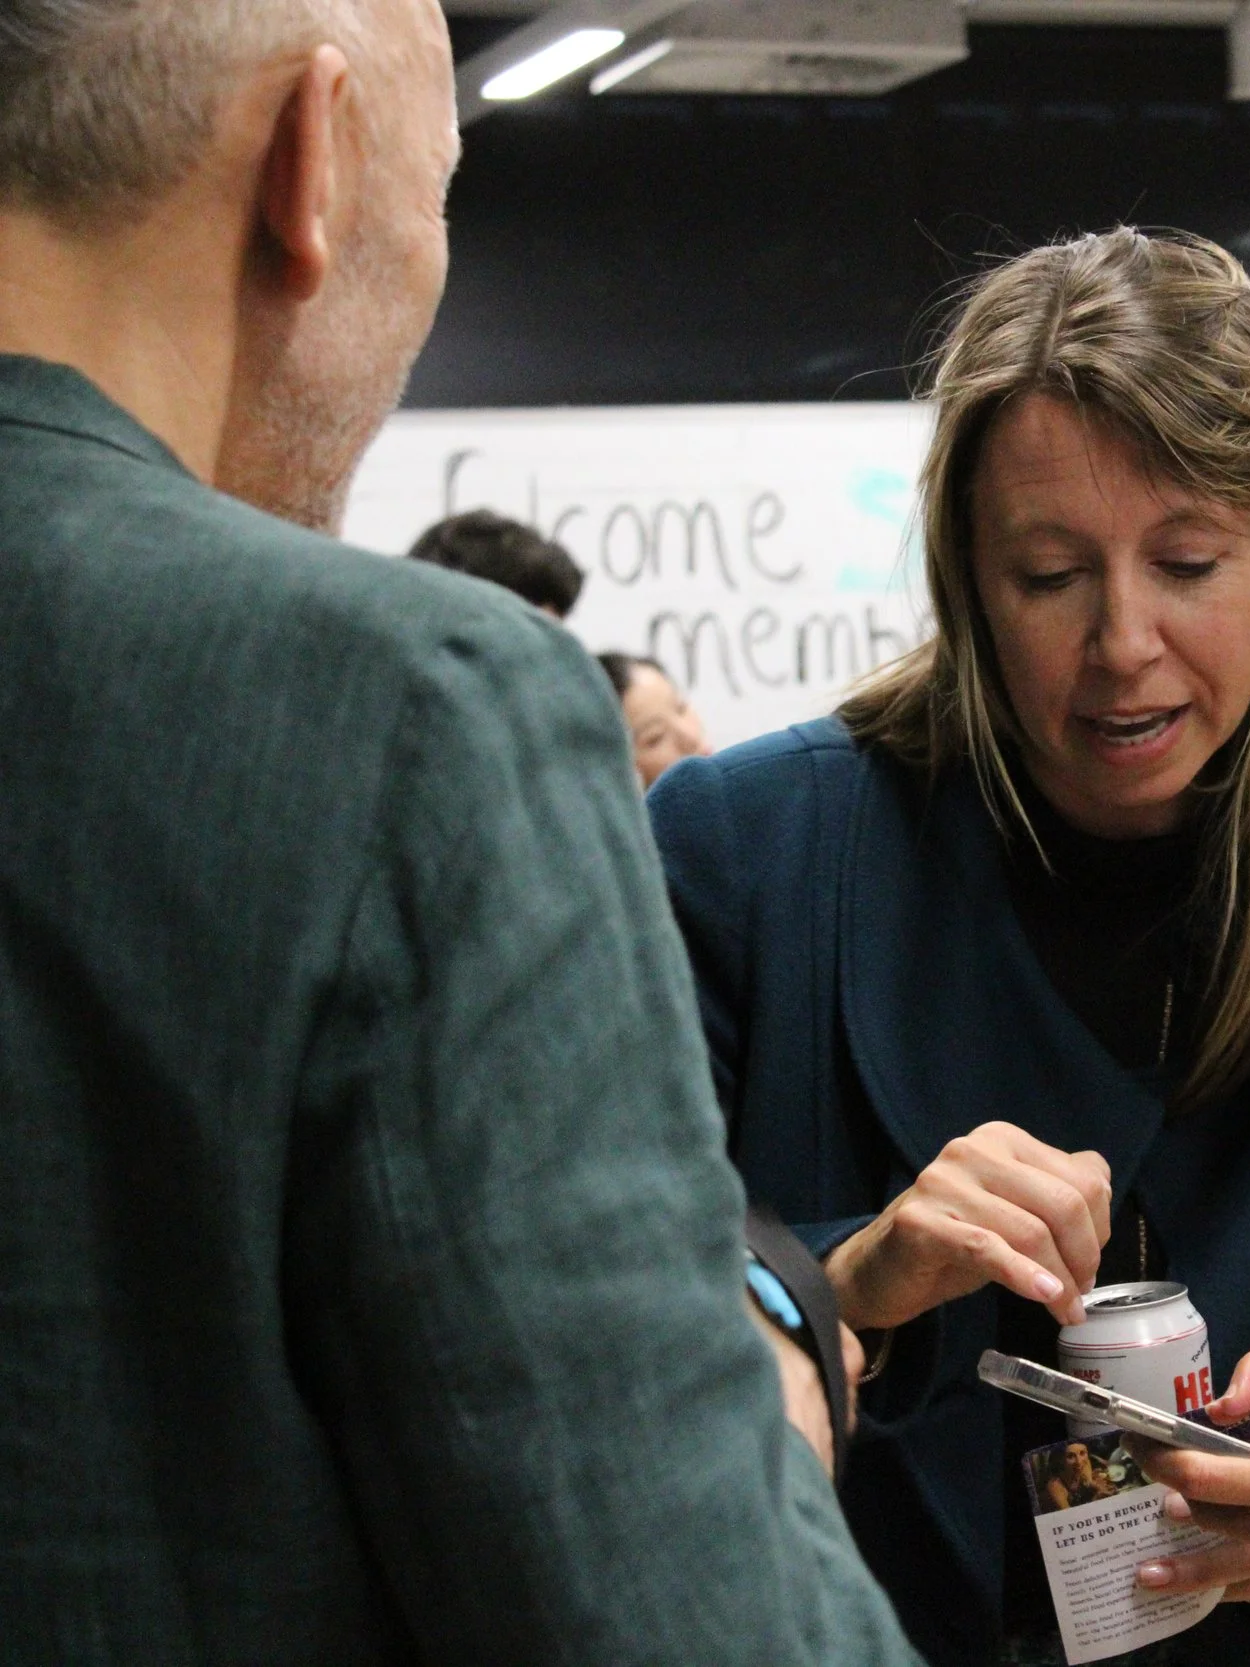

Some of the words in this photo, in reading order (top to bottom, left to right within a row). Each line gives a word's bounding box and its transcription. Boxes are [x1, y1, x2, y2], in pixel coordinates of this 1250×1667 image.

[443, 447, 804, 593] lcome
[647, 602, 930, 700] memb
[1052, 1526, 1065, 1535] IF
[1068, 1513, 1111, 1531] YOU'RE
[1114, 1498, 1159, 1519] HUNGRY
[1055, 1537, 1076, 1549] LET
[1080, 1532, 1094, 1543] US
[1098, 1525, 1115, 1537] DO
[1118, 1518, 1140, 1530] THE
